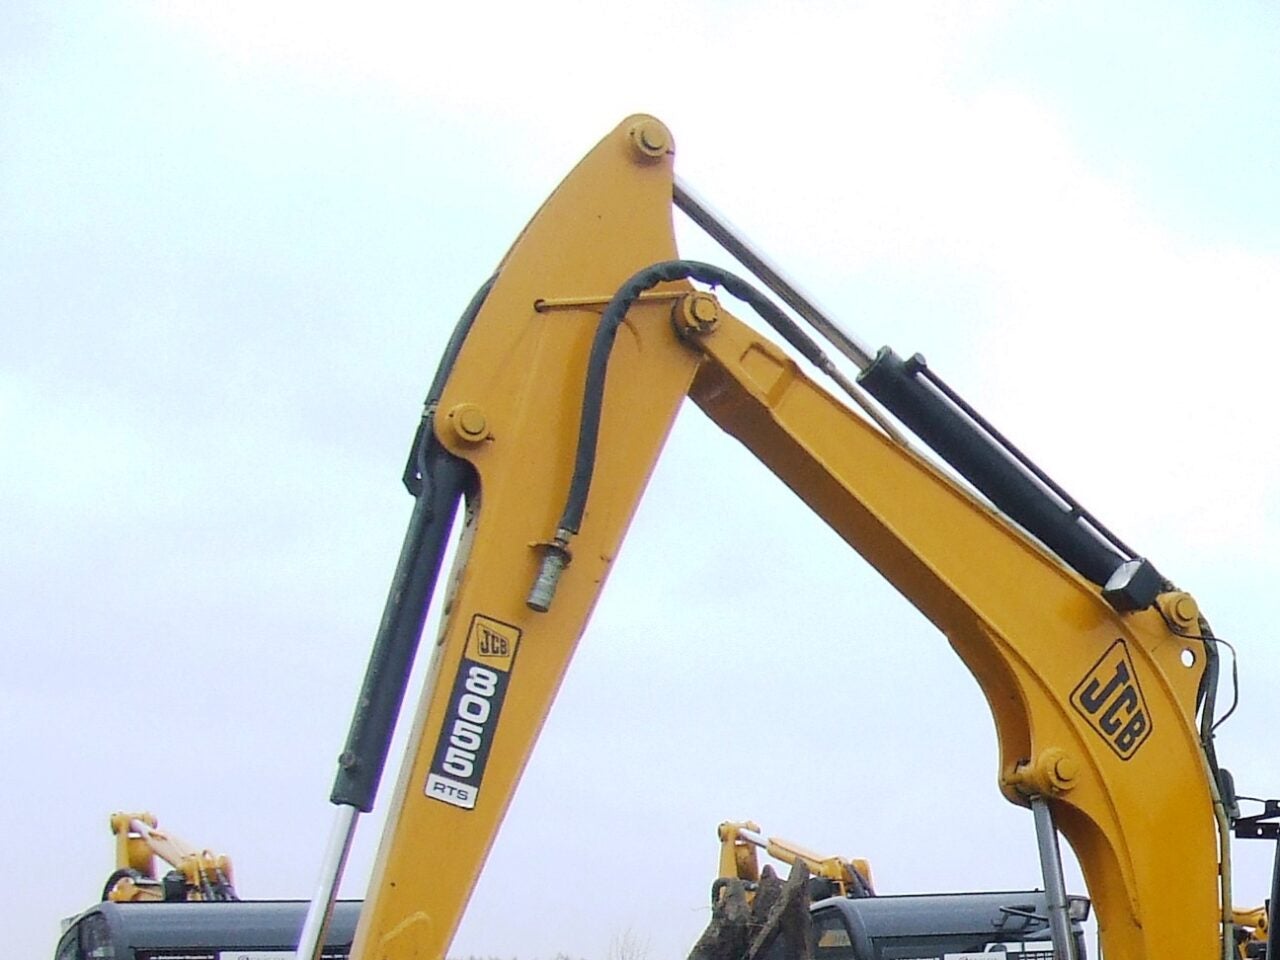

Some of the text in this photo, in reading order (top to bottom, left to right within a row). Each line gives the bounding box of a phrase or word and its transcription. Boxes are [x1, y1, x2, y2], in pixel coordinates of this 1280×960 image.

[480, 630, 509, 655] JCB
[442, 666, 498, 778] 8055
[1079, 659, 1146, 752] JCB
[433, 781, 469, 801] RTS
